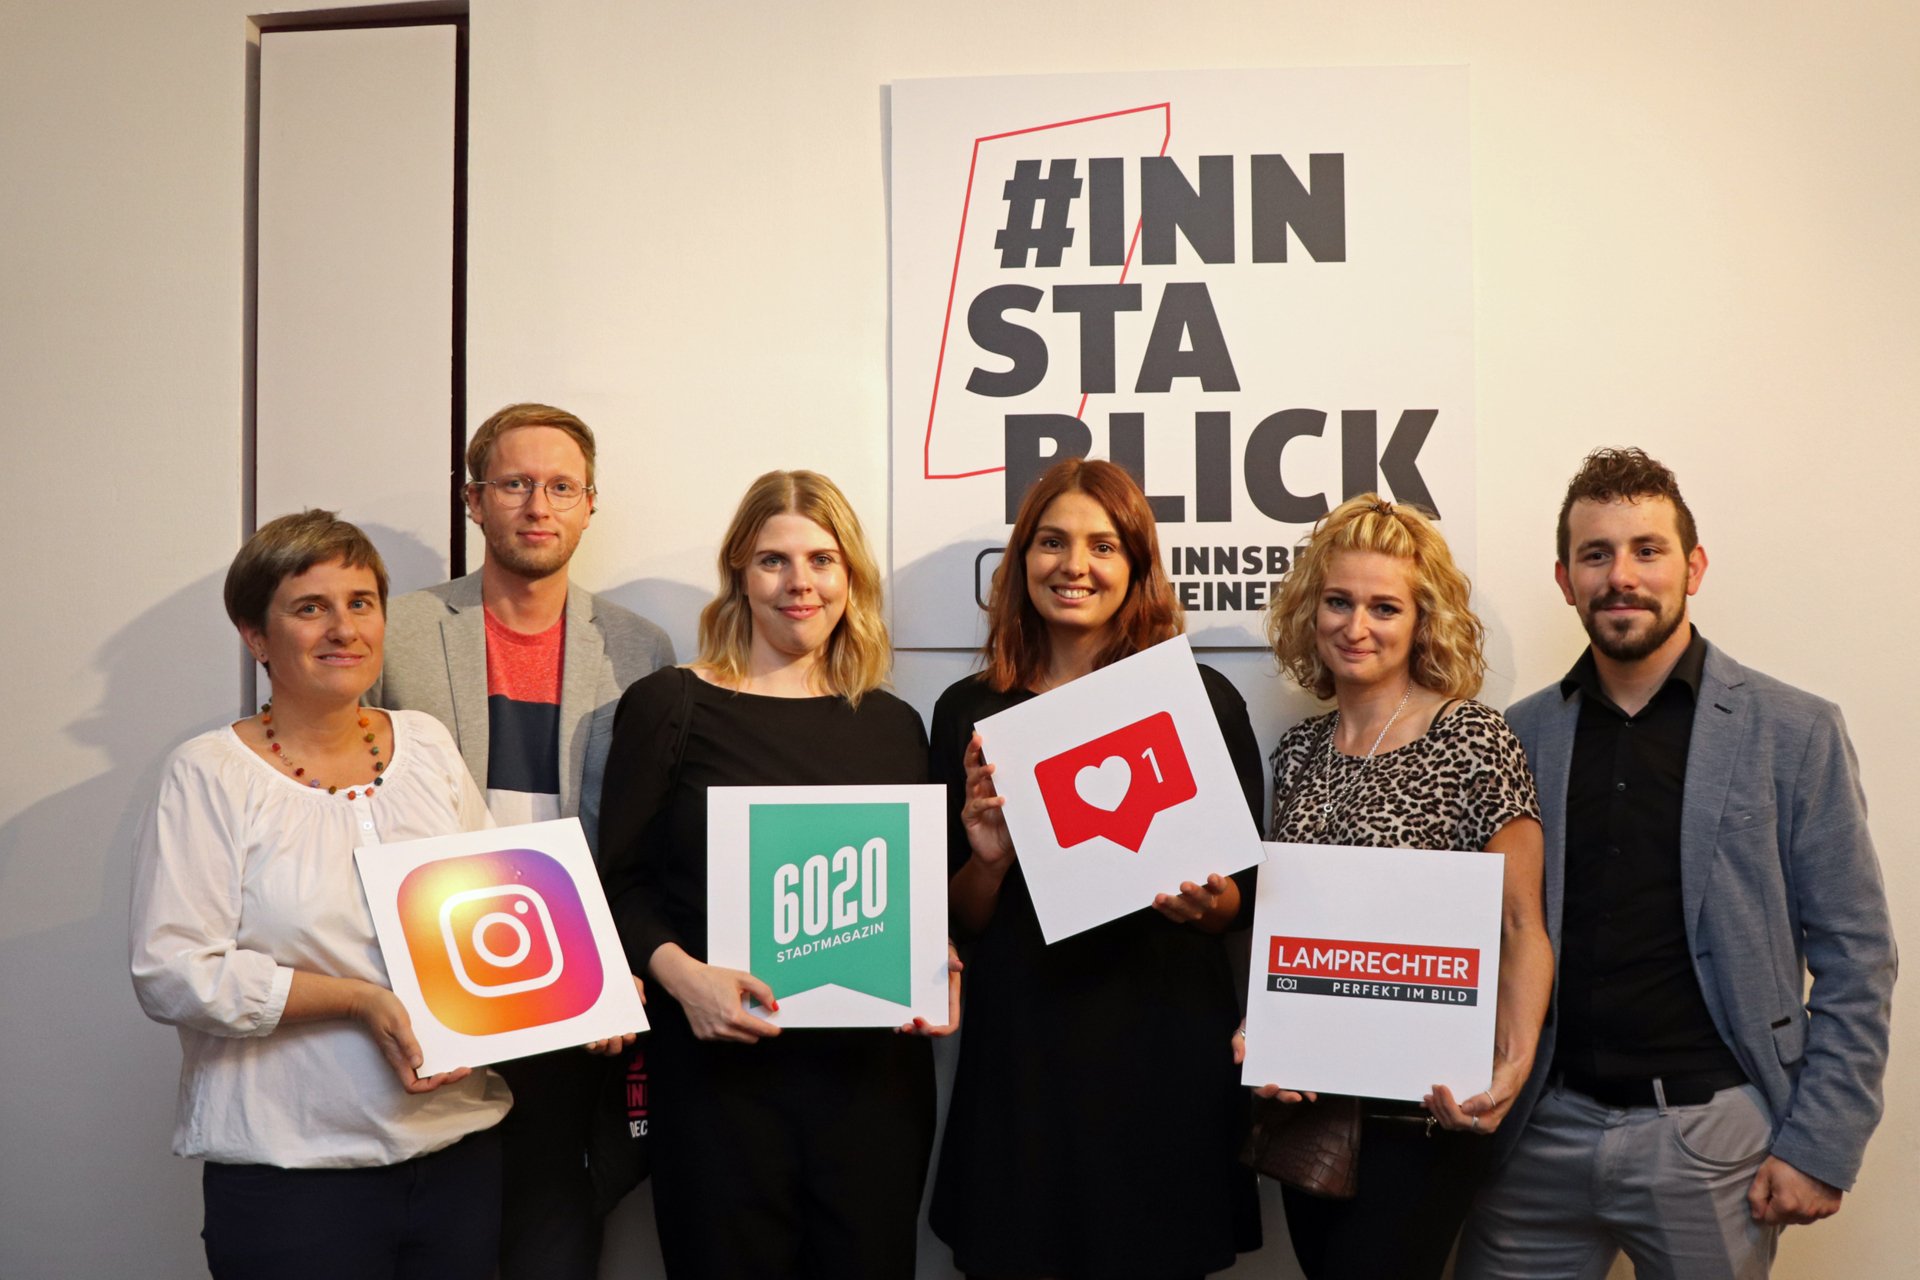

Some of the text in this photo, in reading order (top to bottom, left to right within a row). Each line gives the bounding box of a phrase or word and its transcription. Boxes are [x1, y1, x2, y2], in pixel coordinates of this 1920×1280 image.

[994, 152, 1347, 269] #INN
[965, 281, 1241, 398] STA
[1172, 546, 1309, 575] INNSB
[1168, 581, 1282, 611] EINE
[1141, 747, 1164, 784] 1
[773, 836, 888, 945] 6020
[776, 921, 885, 963] STADTMAGAZIN
[1277, 945, 1469, 980] LAMPRECHTER
[1332, 981, 1468, 1002] PERFEKT IM BILD
